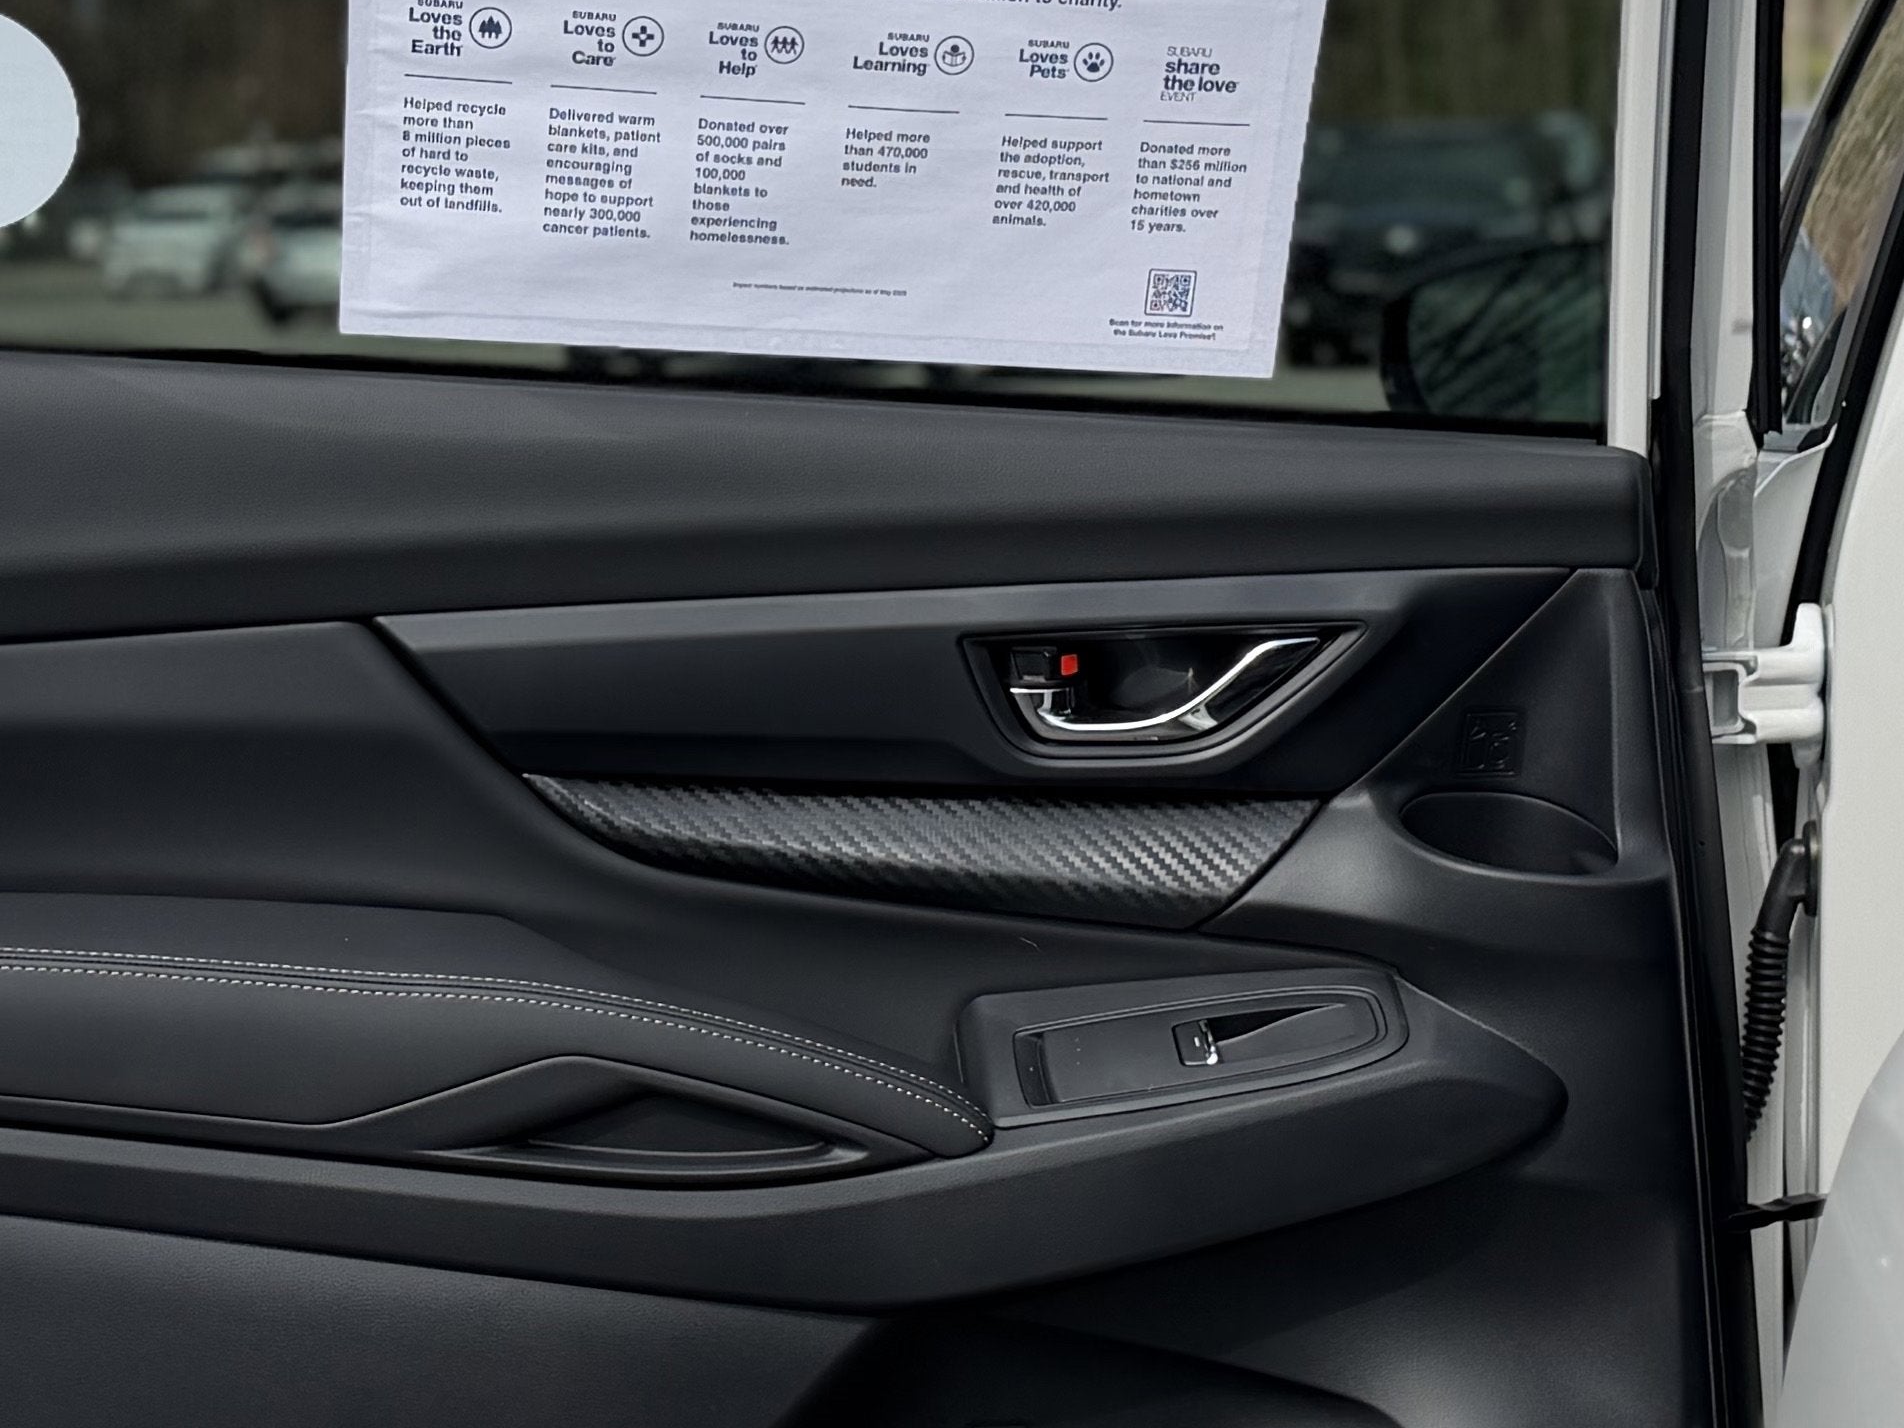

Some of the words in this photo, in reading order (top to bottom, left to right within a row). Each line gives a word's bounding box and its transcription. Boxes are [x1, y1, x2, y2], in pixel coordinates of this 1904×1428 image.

[408, 6, 464, 27] Loves
[571, 10, 617, 23] SUBARU
[431, 24, 463, 42] the
[563, 19, 617, 39] Loves
[716, 21, 760, 33] SUBARU
[596, 38, 616, 53] to
[708, 30, 759, 48] Loves
[887, 31, 931, 43] SUBARU
[1027, 39, 1070, 50] SUBARU
[410, 38, 464, 58] Earth
[740, 47, 758, 62] to
[878, 40, 929, 59] Loves
[1018, 47, 1069, 65] Loves
[571, 50, 617, 67] Care
[852, 55, 931, 77] Learning
[1164, 57, 1221, 77] share
[718, 60, 758, 79] Help
[1029, 62, 1070, 80] Pets
[1162, 74, 1196, 93] the
[1197, 75, 1240, 94] love
[1159, 90, 1197, 103] EVENT
[403, 96, 453, 114] Helped
[456, 102, 507, 118] recycle
[402, 115, 439, 128] more
[442, 116, 474, 131] than
[548, 107, 615, 124] Delivered
[617, 114, 656, 127] warm
[548, 123, 611, 142] blankets,
[613, 129, 661, 144] patient
[697, 117, 756, 133] Donated
[758, 124, 789, 136] over
[402, 129, 411, 142] 8
[414, 130, 462, 146] million
[465, 134, 511, 150] pieces
[697, 133, 749, 149] 500,000
[751, 138, 786, 153] pairs
[845, 127, 893, 144] Helped
[896, 133, 931, 144] more
[1001, 135, 1048, 151] Helped
[1050, 139, 1103, 153] support
[401, 145, 416, 158] of
[419, 146, 452, 161] hard
[454, 149, 469, 163] to
[546, 142, 578, 154] care
[580, 142, 610, 158] kits,
[612, 145, 639, 158] and
[844, 143, 874, 157] than
[877, 145, 929, 160] 470,000
[1139, 141, 1195, 155] Donated
[1197, 146, 1232, 157] more
[546, 158, 633, 177] encouraging
[695, 150, 710, 163] of
[712, 152, 753, 166] socks
[756, 155, 783, 168] and
[842, 160, 901, 174] students
[904, 161, 917, 175] in
[999, 151, 1021, 164] the
[1023, 152, 1086, 168] adoption,
[1137, 156, 1167, 170] than
[1169, 158, 1201, 171] $256
[1203, 159, 1248, 173] million
[400, 163, 452, 178] recycle
[454, 167, 499, 182] waste,
[695, 166, 746, 182] 100,000
[997, 168, 1046, 182] rescue,
[1049, 169, 1110, 185] transport
[1135, 173, 1149, 185] to
[1151, 173, 1205, 187] national
[1207, 176, 1233, 188] and
[400, 177, 456, 197] keeping
[458, 181, 494, 197] them
[545, 174, 615, 191] messages
[618, 177, 633, 190] of
[693, 181, 750, 198] blankets
[754, 186, 768, 199] to
[840, 175, 877, 188] need.
[995, 182, 1022, 195] and
[1023, 183, 1065, 197] health
[1067, 185, 1083, 197] of
[544, 187, 579, 205] hope
[582, 191, 597, 204] to
[600, 194, 654, 209] support
[1133, 187, 1201, 203] hometown
[399, 195, 423, 208] out
[425, 196, 441, 209] of
[444, 196, 503, 214] landfills.
[692, 198, 730, 212] those
[993, 199, 1024, 211] over
[1026, 198, 1077, 214] 420,000
[1130, 203, 1187, 218] charities
[1190, 208, 1219, 219] over
[543, 206, 586, 222] nearly
[589, 207, 642, 223] 300,000
[992, 213, 1047, 227] animals.
[542, 222, 590, 235] cancer
[592, 224, 651, 239] patients.
[690, 215, 778, 232] experiencing
[1130, 218, 1145, 232] 15
[1147, 222, 1186, 234] years.
[689, 229, 790, 245] homelessness.
